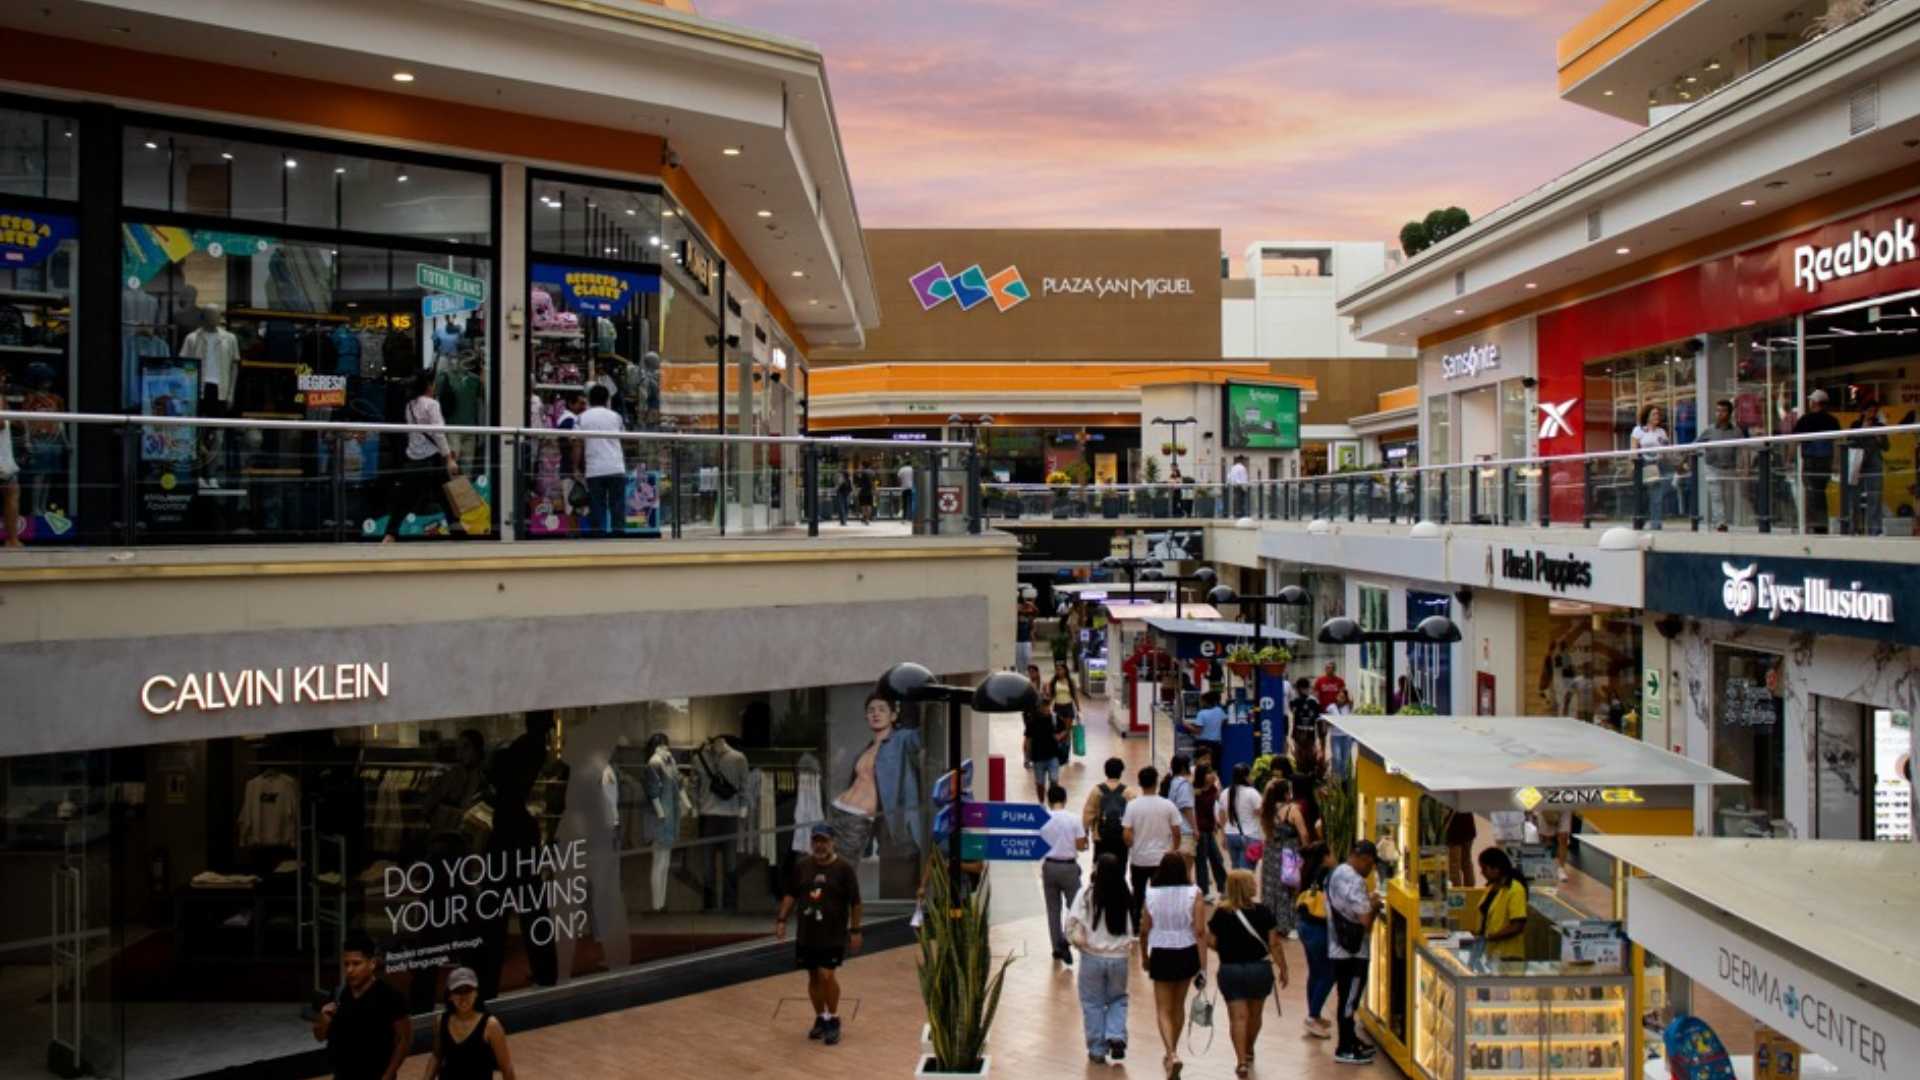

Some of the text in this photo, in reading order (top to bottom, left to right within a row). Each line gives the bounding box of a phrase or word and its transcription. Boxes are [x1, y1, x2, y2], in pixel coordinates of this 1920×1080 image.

[1795, 217, 1917, 293] Reebok
[453, 276, 482, 298] JEANS
[1042, 277, 1195, 299] PLAZA SAN MIGUEL
[358, 312, 411, 331] JEANS
[1502, 548, 1592, 592] Hush Puppies
[1757, 573, 1894, 623] Eyes Illusion
[141, 662, 389, 715] CALVIN KLEIN
[1001, 810, 1036, 823] PUMA
[1001, 838, 1037, 848] CONEY
[1006, 848, 1032, 857] PARK
[384, 839, 587, 899] DO YOU HAVE
[385, 875, 588, 936] YOUR CALVINS
[530, 910, 588, 947] ON?
[1719, 947, 1887, 1072] DERMA CENTER
